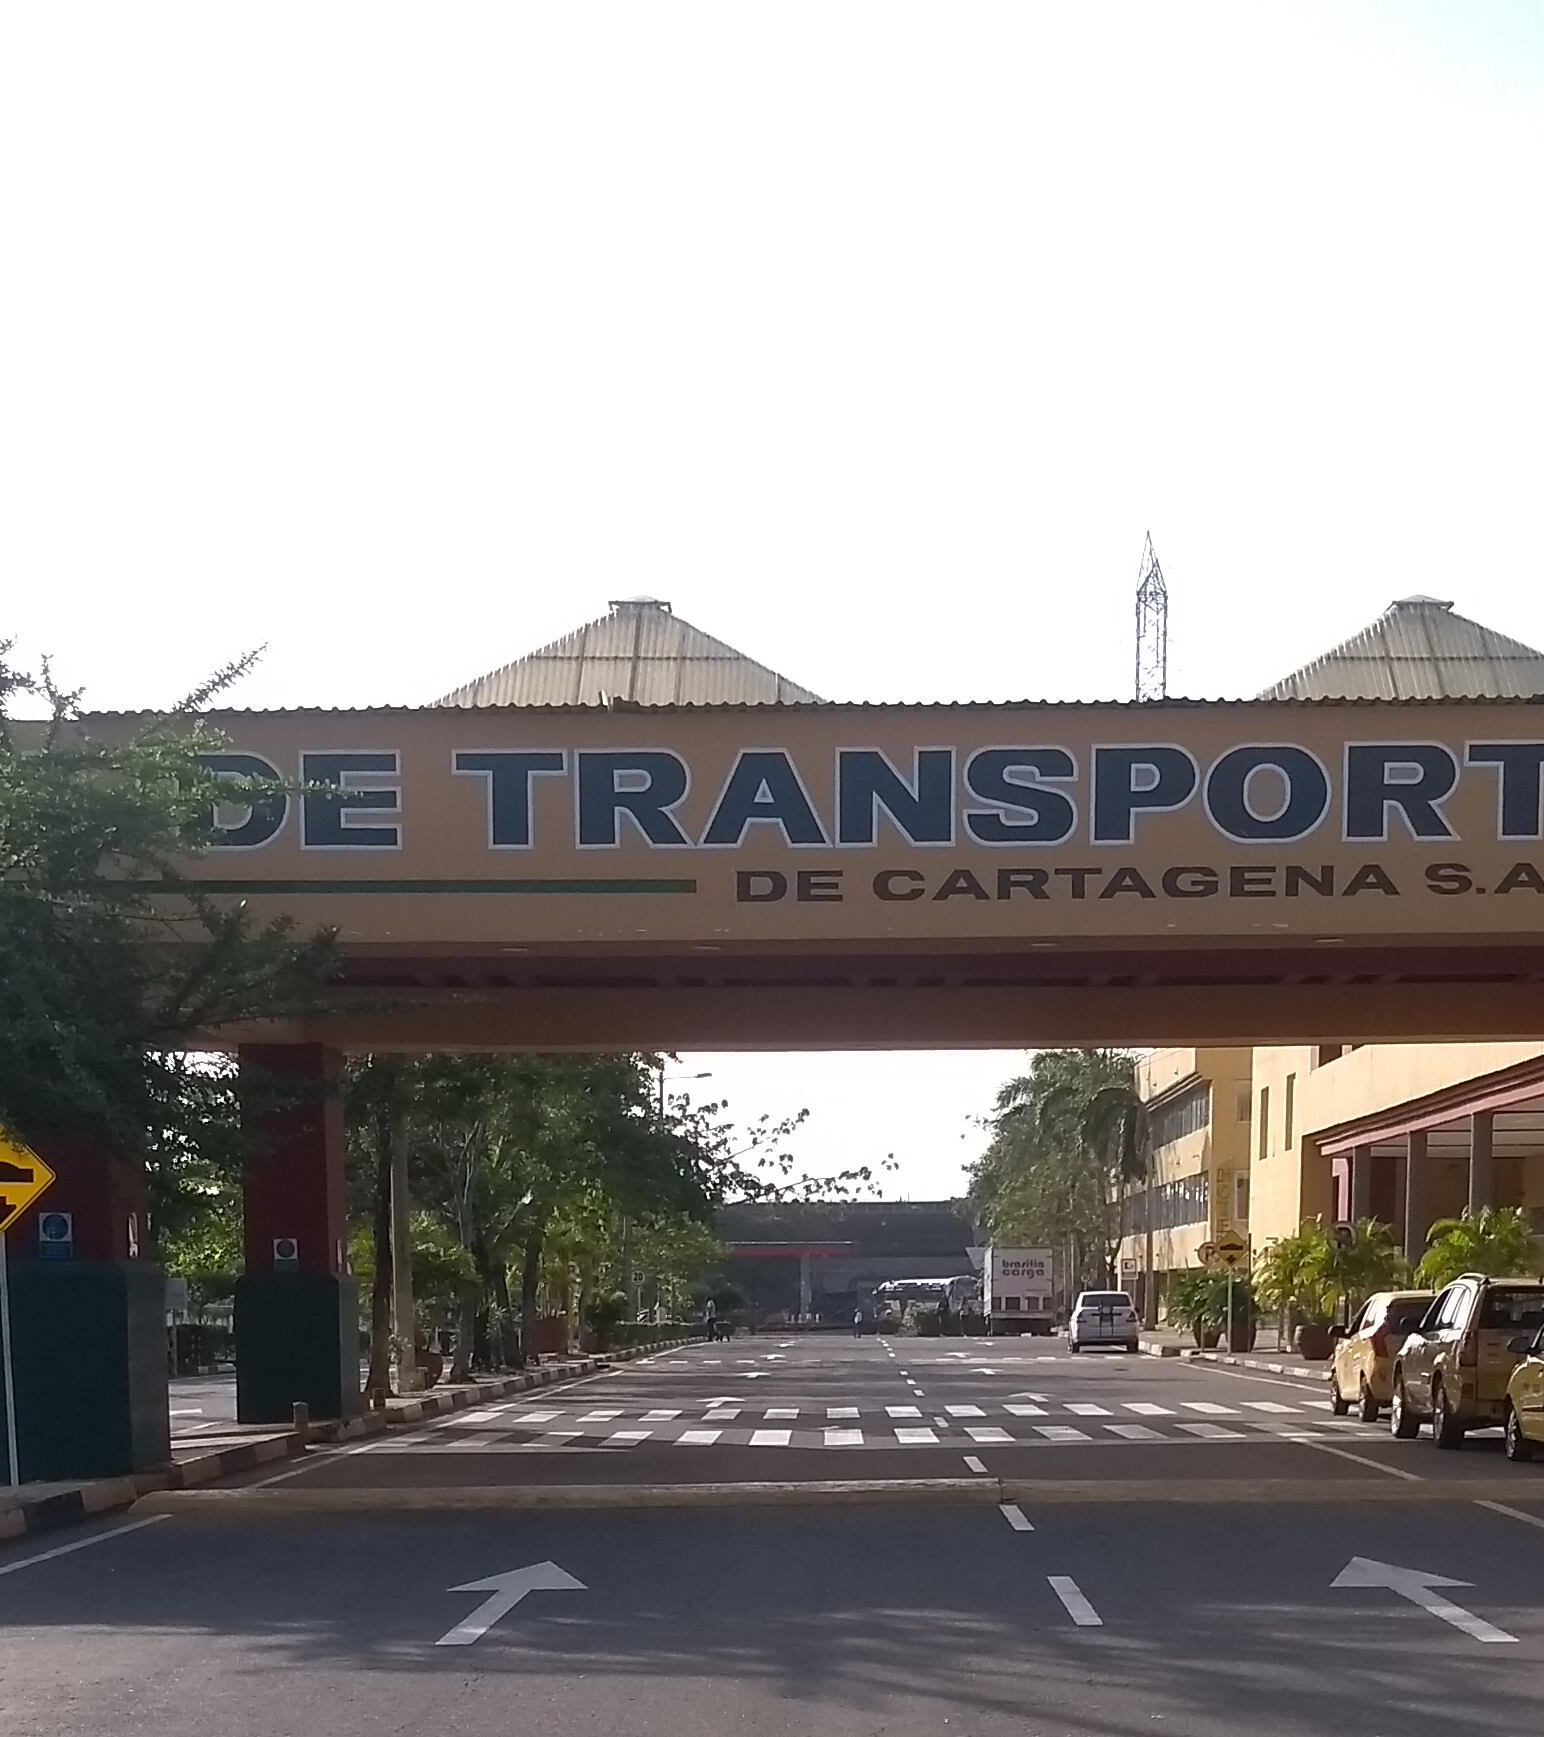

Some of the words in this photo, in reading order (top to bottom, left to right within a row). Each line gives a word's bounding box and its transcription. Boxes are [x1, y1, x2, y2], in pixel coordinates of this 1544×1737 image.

[182, 748, 404, 852] DE
[735, 869, 845, 903] DE
[871, 863, 1401, 902] CARTAGENA
[1001, 1268, 1046, 1280] carga
